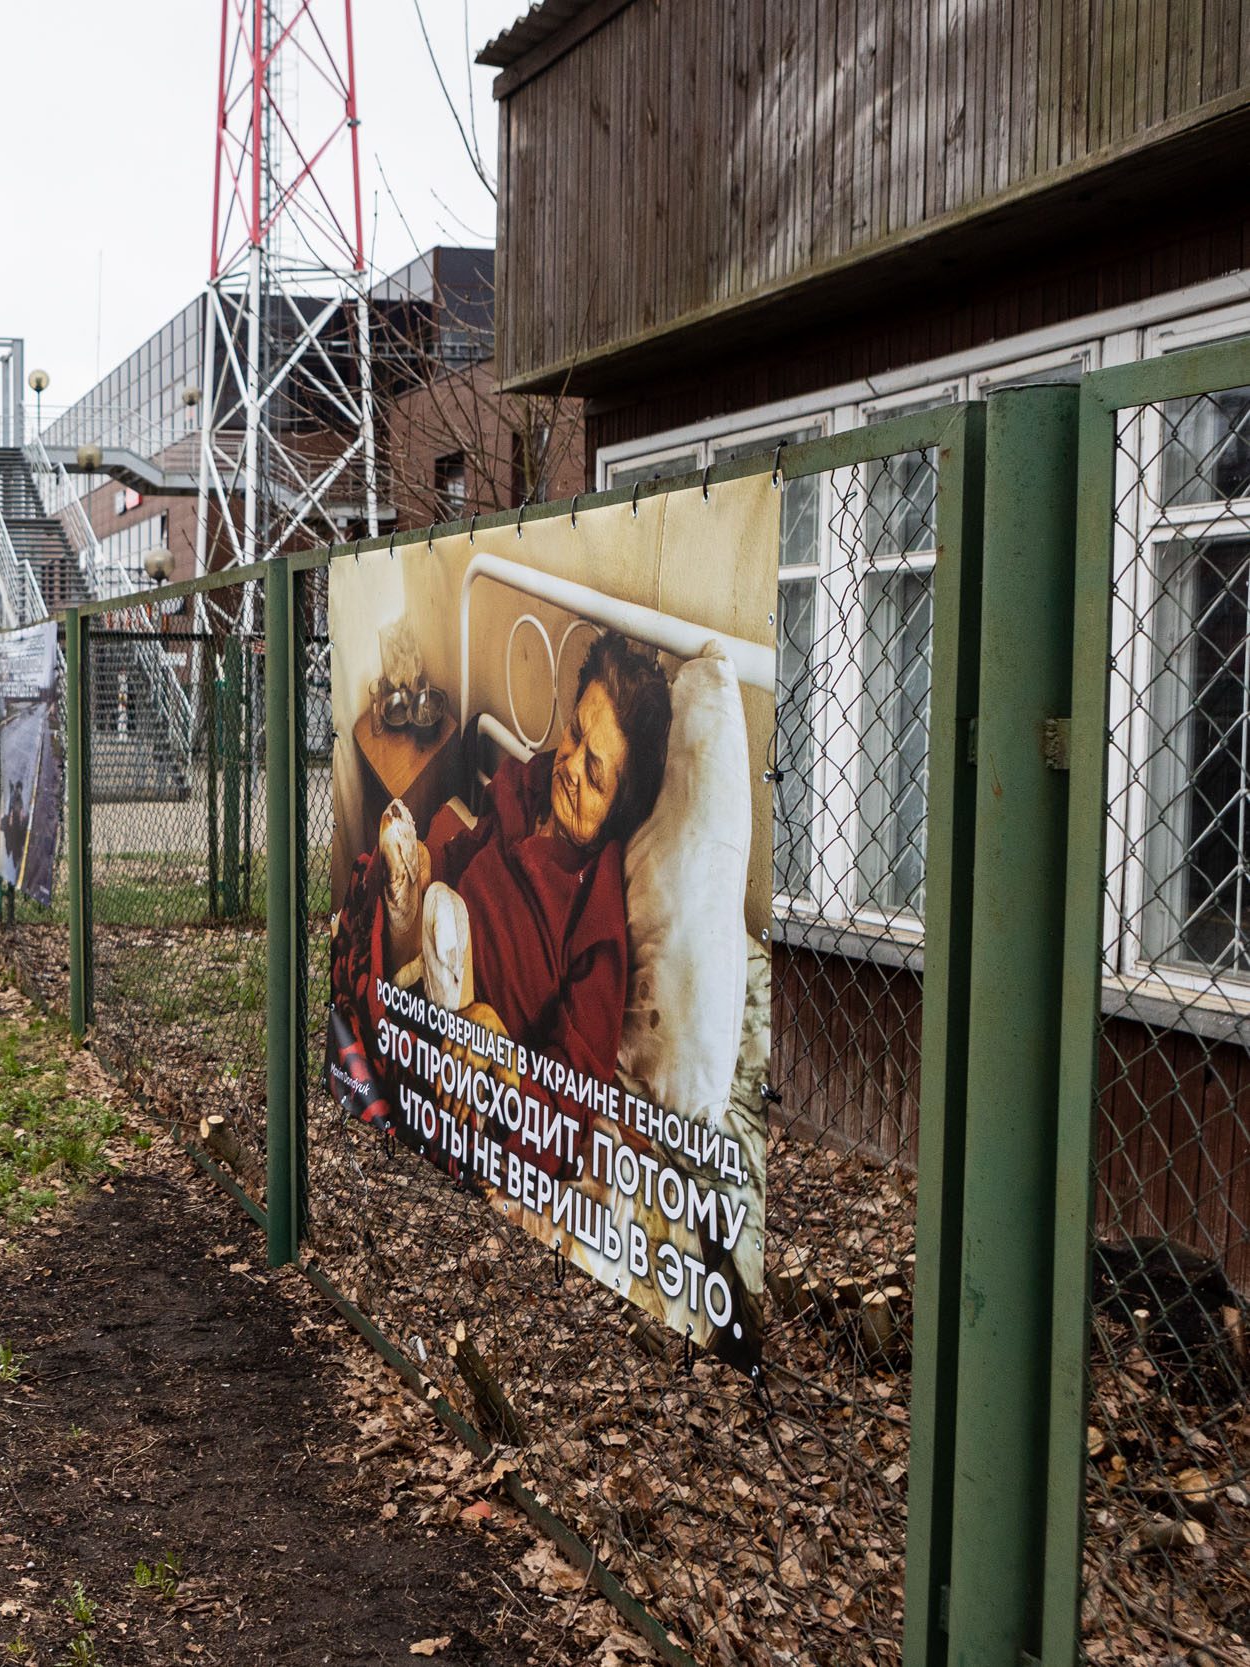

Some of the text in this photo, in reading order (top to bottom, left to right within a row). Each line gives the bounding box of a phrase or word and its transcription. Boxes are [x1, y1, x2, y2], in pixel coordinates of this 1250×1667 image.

[376, 978, 748, 1186] РОССИЯ СОВЕРШАЕТ В УКРАИНЕ ГЕНОЦИД.
[377, 1017, 747, 1251] ЭТО ПРОИСХОДИТ, ПОТОМУ
[400, 1084, 743, 1340] ЧТО ТЫ НЕ ВЕРИШЬ В ЭТО.
